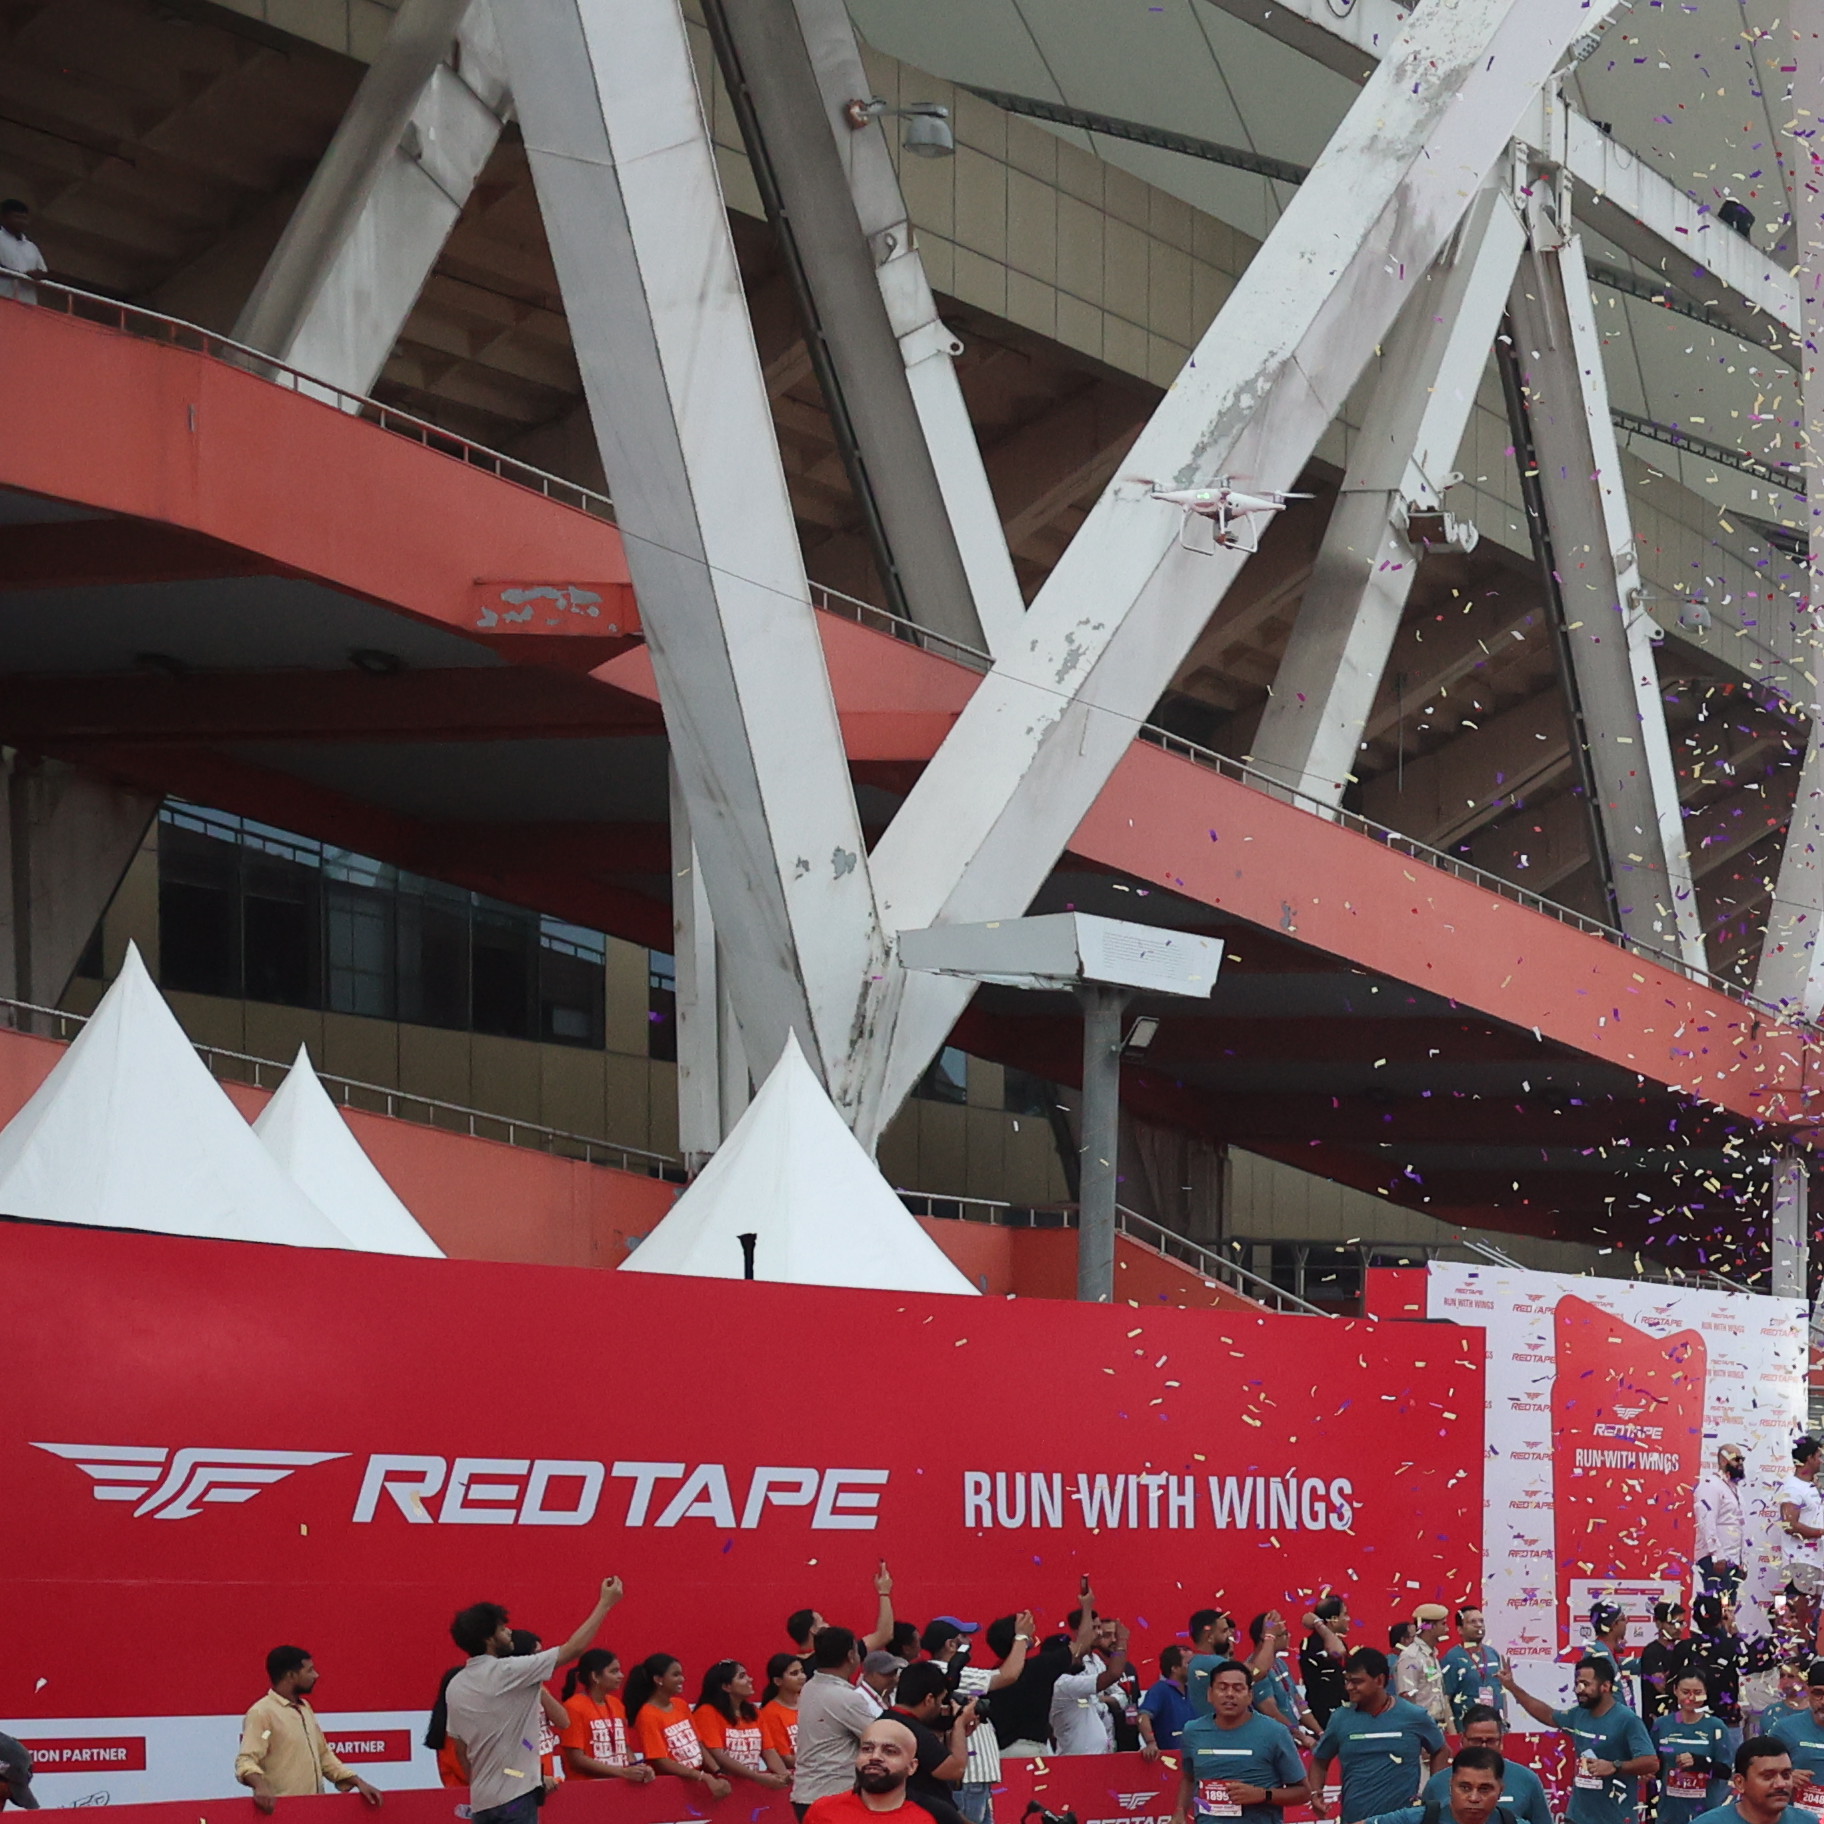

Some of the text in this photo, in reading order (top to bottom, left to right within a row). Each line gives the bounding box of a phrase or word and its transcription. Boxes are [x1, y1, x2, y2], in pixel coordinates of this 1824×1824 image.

[1511, 1401, 1551, 1413] REDTAP
[1593, 1422, 1664, 1440] REDTAPE
[1575, 1448, 1602, 1468] RUN
[1604, 1450, 1635, 1470] WITH
[352, 1453, 891, 1531] REDTAPE
[963, 1470, 1354, 1532] RUN WITH WINGS
[62, 1748, 127, 1762] PARTNER
[328, 1740, 385, 1754] PARTNER
